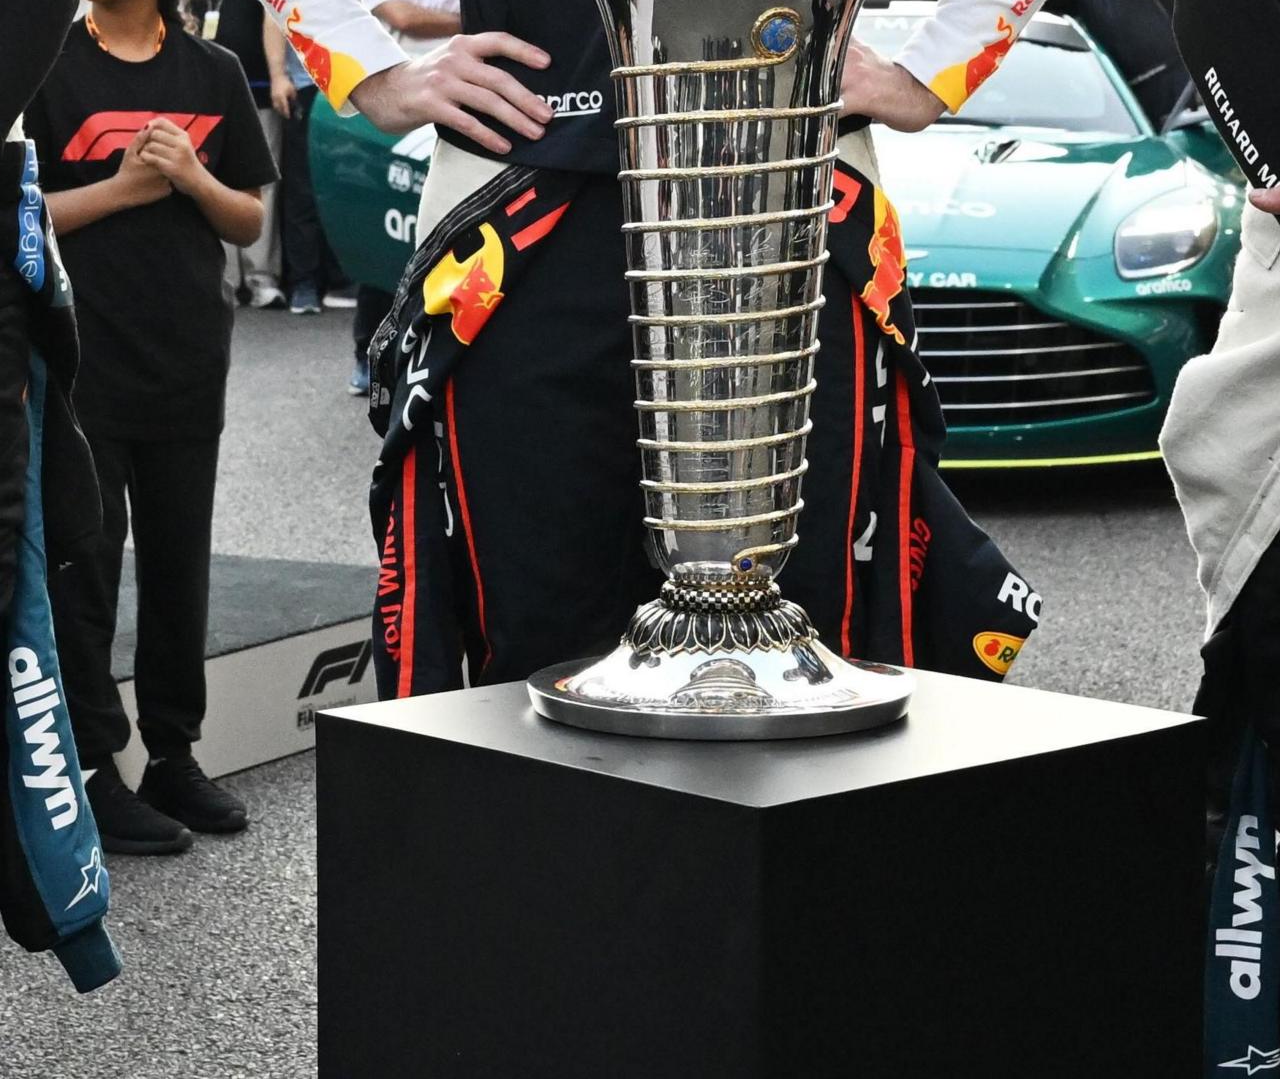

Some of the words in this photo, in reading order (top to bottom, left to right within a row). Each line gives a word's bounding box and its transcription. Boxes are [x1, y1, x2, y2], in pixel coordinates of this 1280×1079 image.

[1203, 66, 1260, 166] RICHARD
[928, 271, 977, 288] CAR
[381, 603, 402, 662] YOU
[8, 645, 80, 832] allwyn
[1215, 813, 1277, 1001] allwyn
